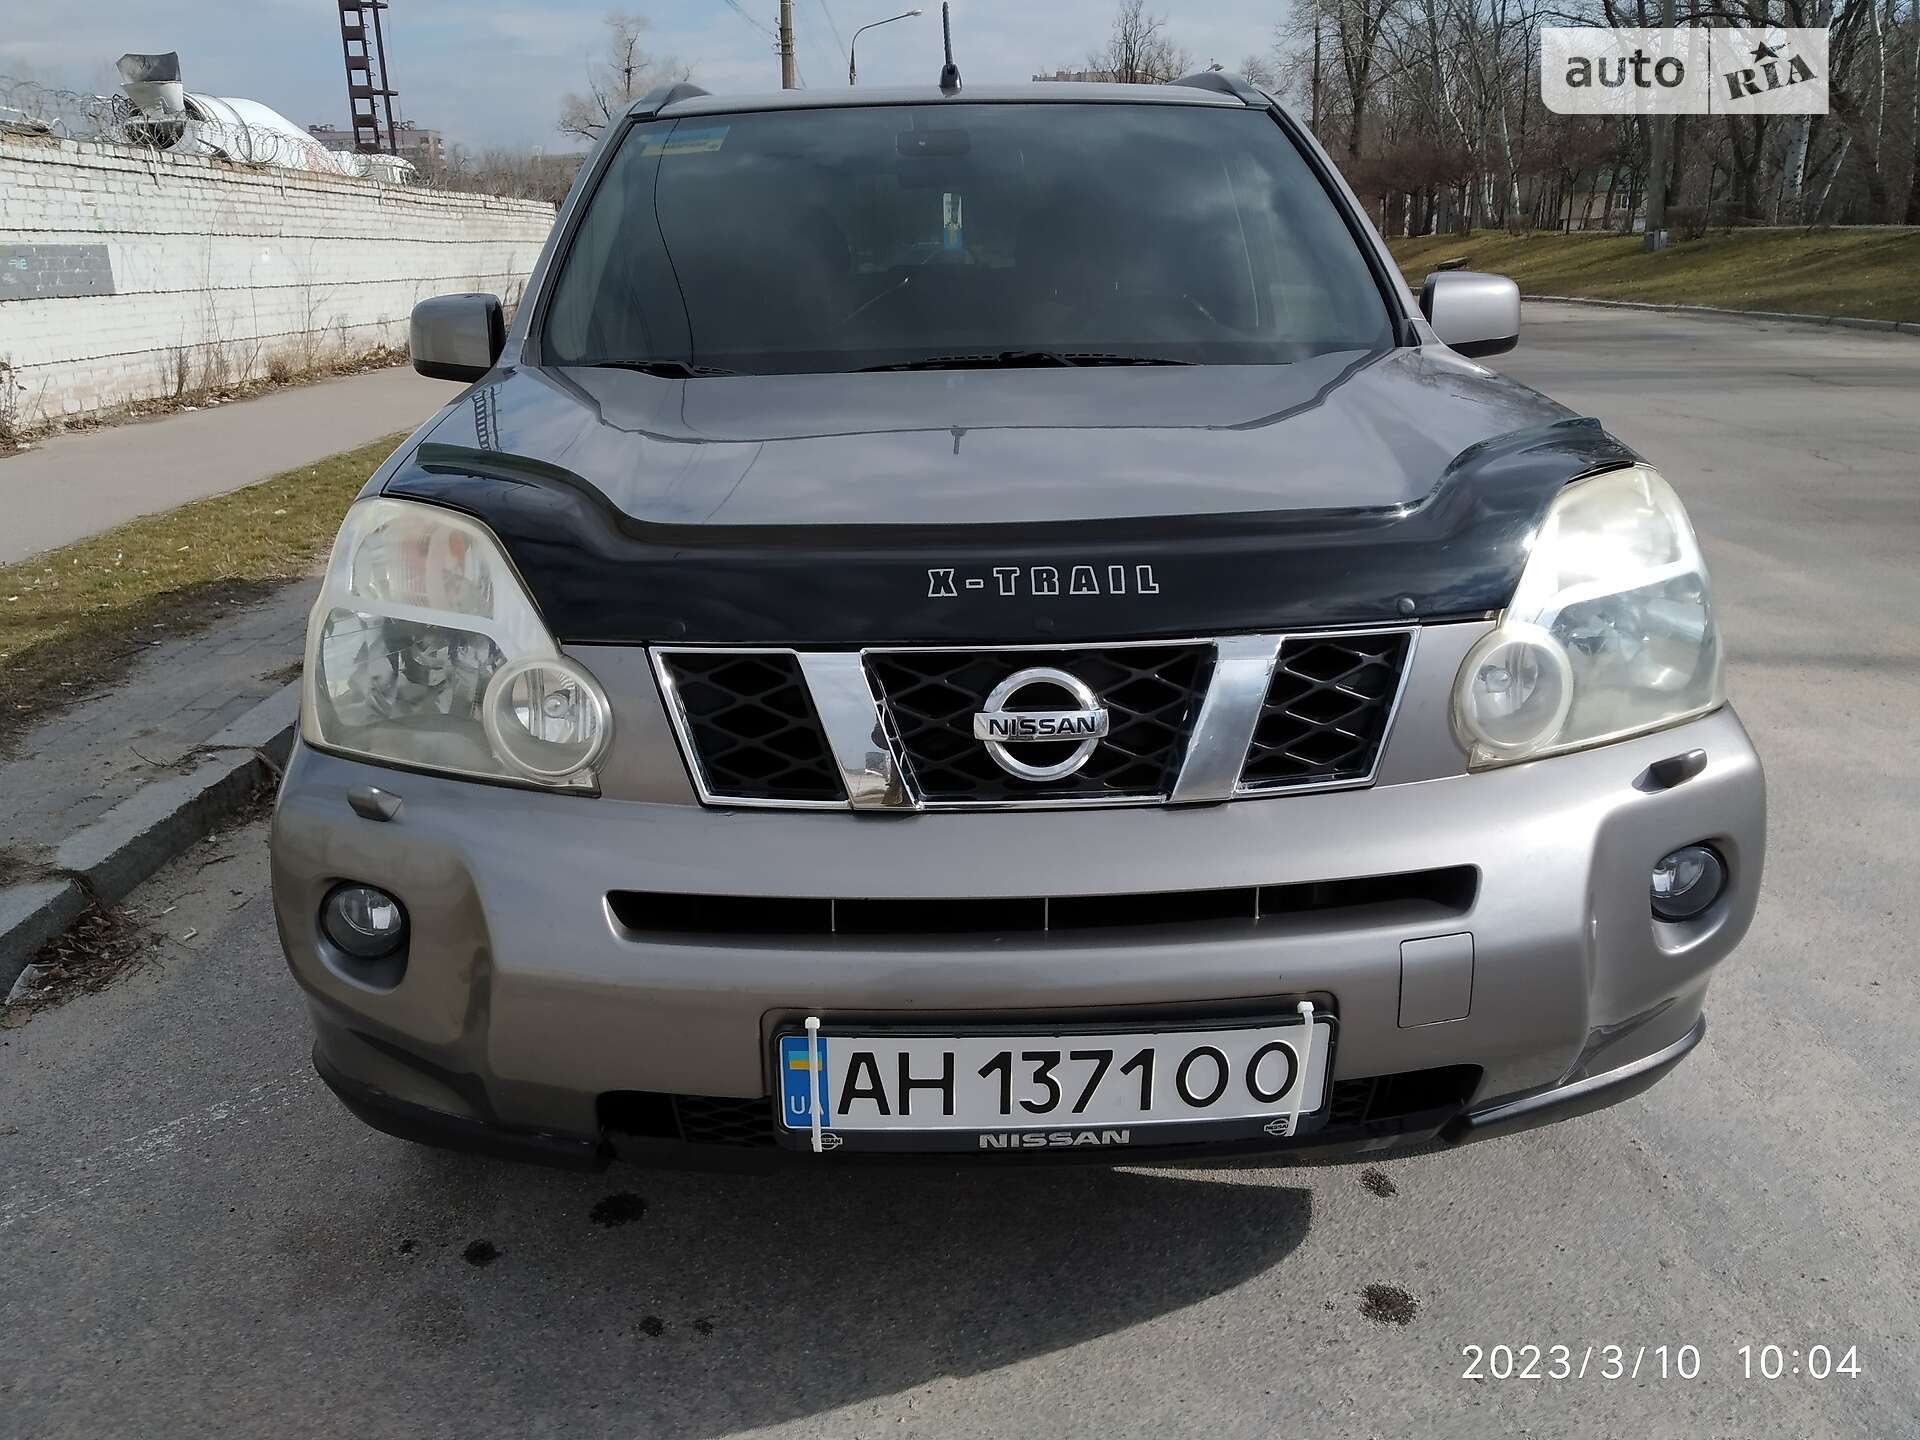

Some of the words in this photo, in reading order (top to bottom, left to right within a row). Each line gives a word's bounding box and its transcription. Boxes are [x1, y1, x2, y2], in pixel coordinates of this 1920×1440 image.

[927, 565, 1160, 598] X-TRAIL
[989, 716, 1096, 736] NISSAN
[837, 1051, 955, 1116] AH
[977, 1048, 1155, 1115] 1371
[979, 1130, 1130, 1149] NISSAN
